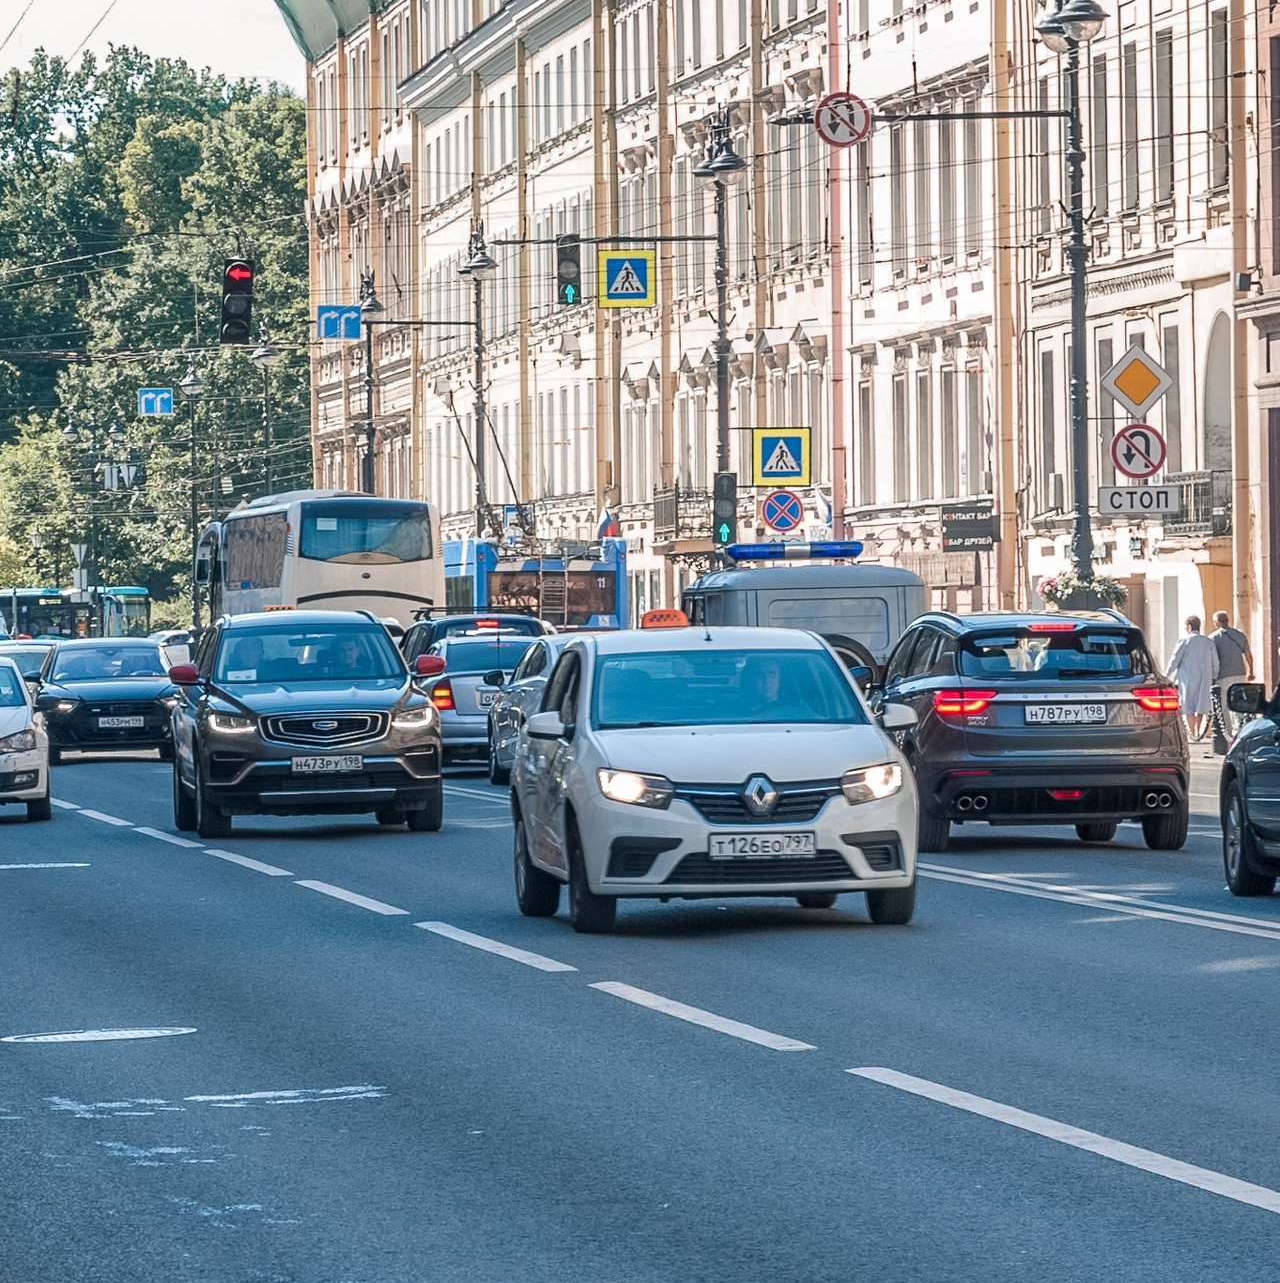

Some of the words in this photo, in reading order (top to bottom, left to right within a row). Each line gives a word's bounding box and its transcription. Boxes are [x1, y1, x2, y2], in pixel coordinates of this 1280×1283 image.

[1110, 491, 1168, 509] СТОП
[597, 577, 606, 588] 11
[1084, 706, 1103, 715] 198
[343, 757, 360, 765] 198
[784, 835, 810, 848] 797
